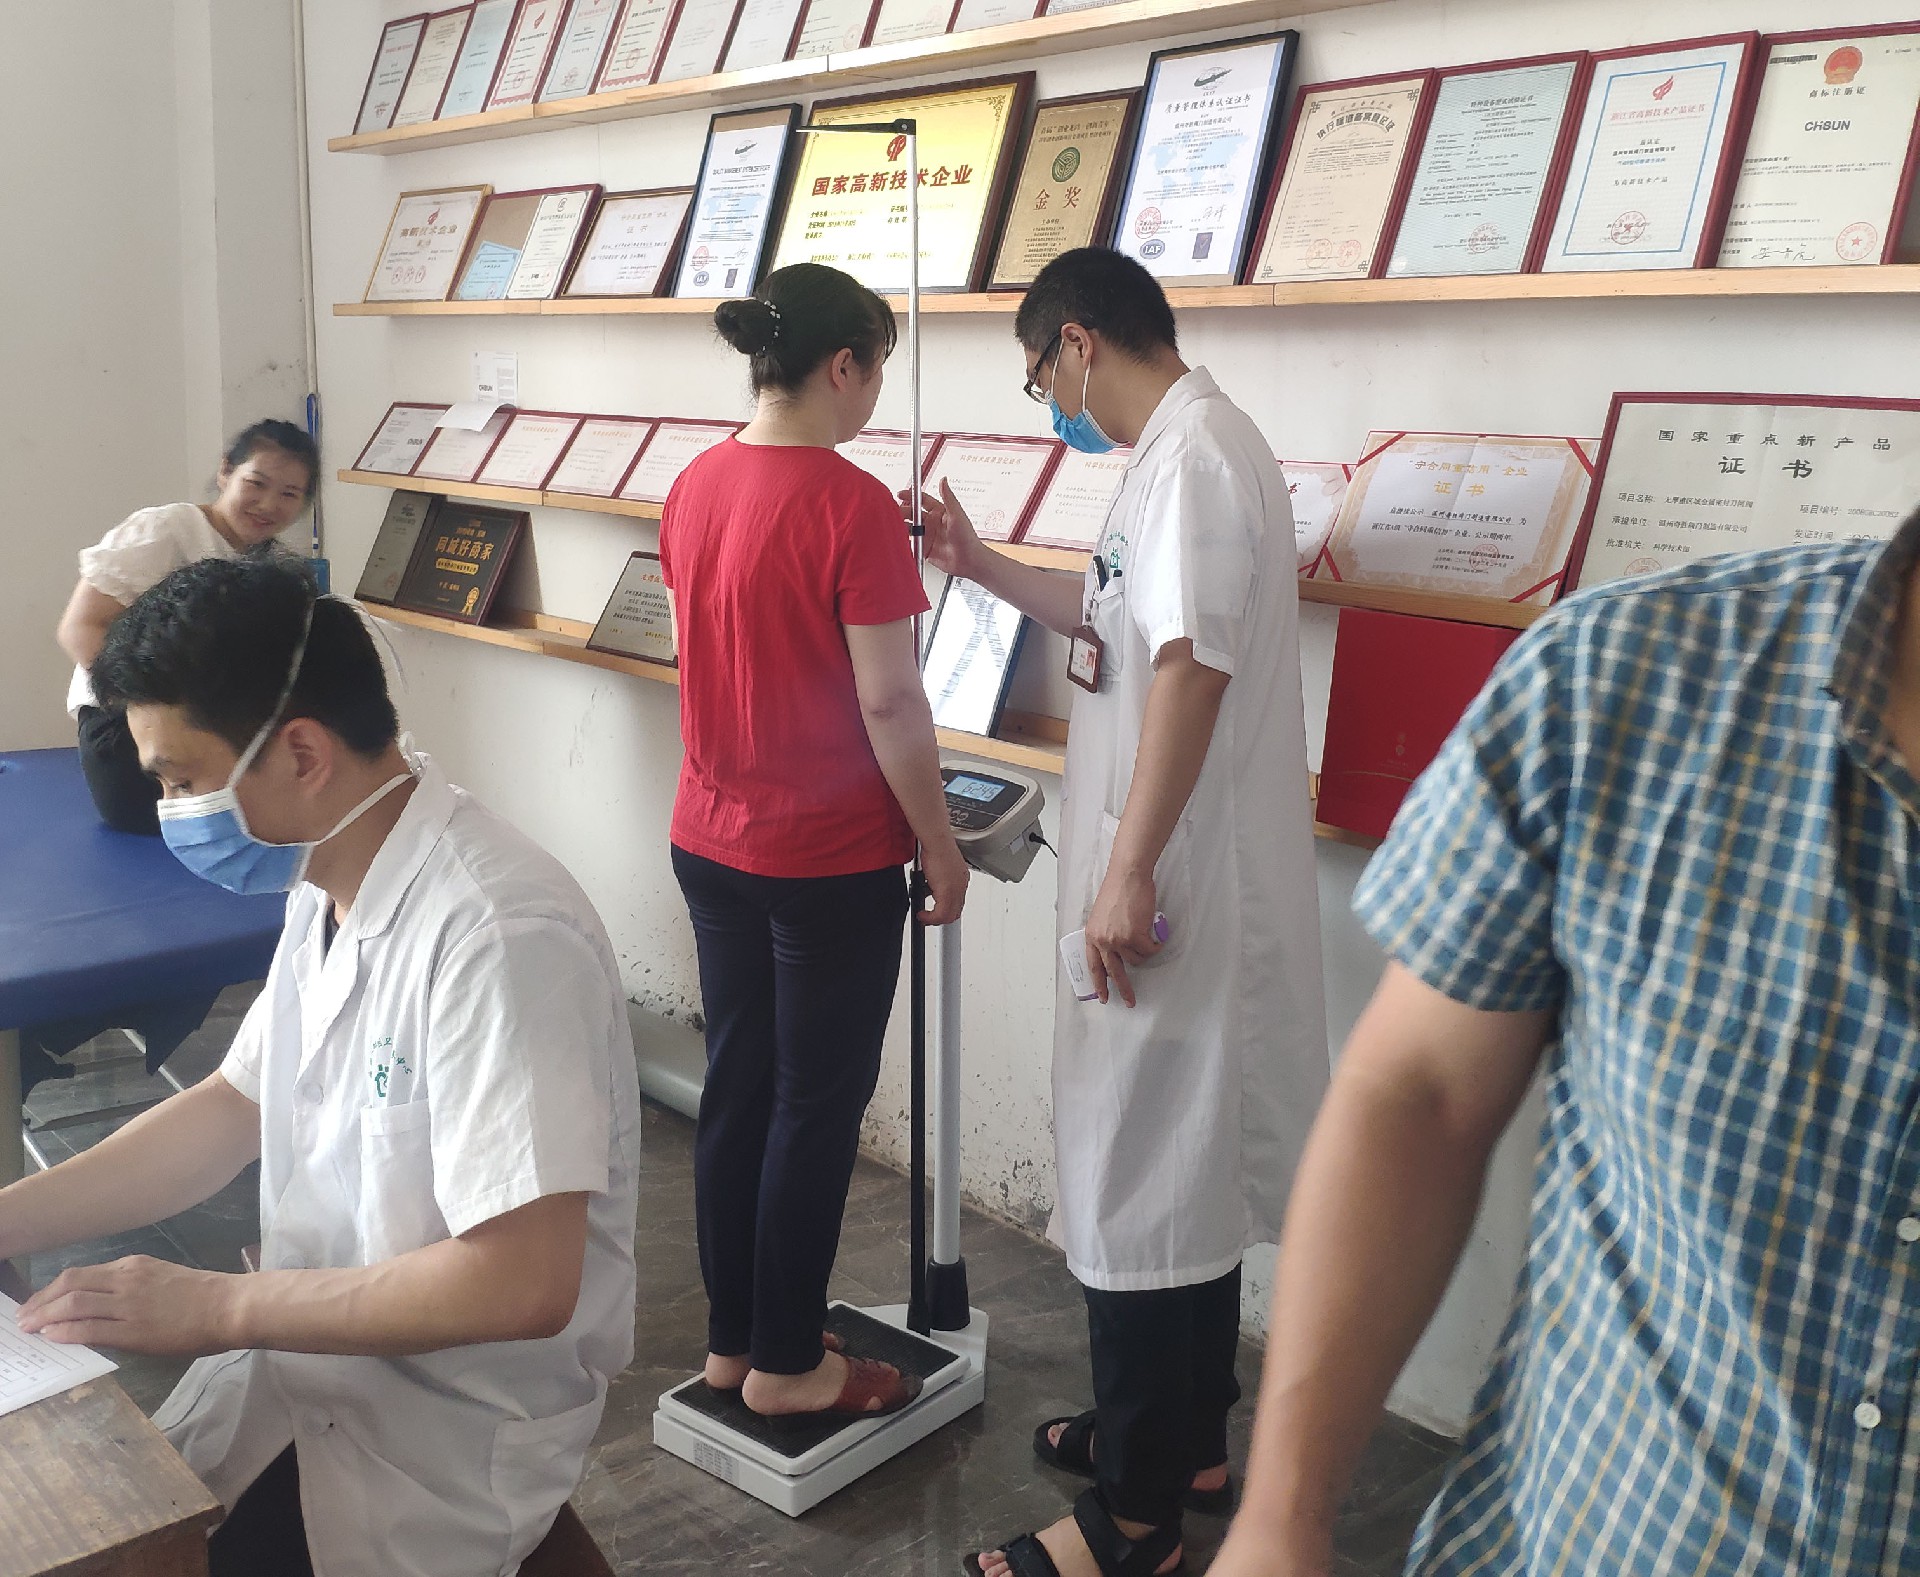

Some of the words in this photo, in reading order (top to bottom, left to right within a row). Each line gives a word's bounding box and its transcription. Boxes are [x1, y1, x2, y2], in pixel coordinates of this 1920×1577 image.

[1809, 86, 1867, 98] 商标注册证
[1165, 94, 1252, 114] 质量管理体系认证证书
[1610, 103, 1706, 121] 浙江省高新技术产品证书
[1316, 112, 1396, 139] 执行标准备案登记证
[1033, 186, 1082, 211] 金奖
[1144, 245, 1162, 254] IAF
[1658, 429, 1891, 451] 国家重点新产品
[959, 453, 1023, 466] 科学技术成果登记证书
[1717, 455, 1813, 479] 证书
[1433, 481, 1486, 497] 证书
[1519, 517, 1527, 525] 为
[435, 536, 494, 560] 同城好商家
